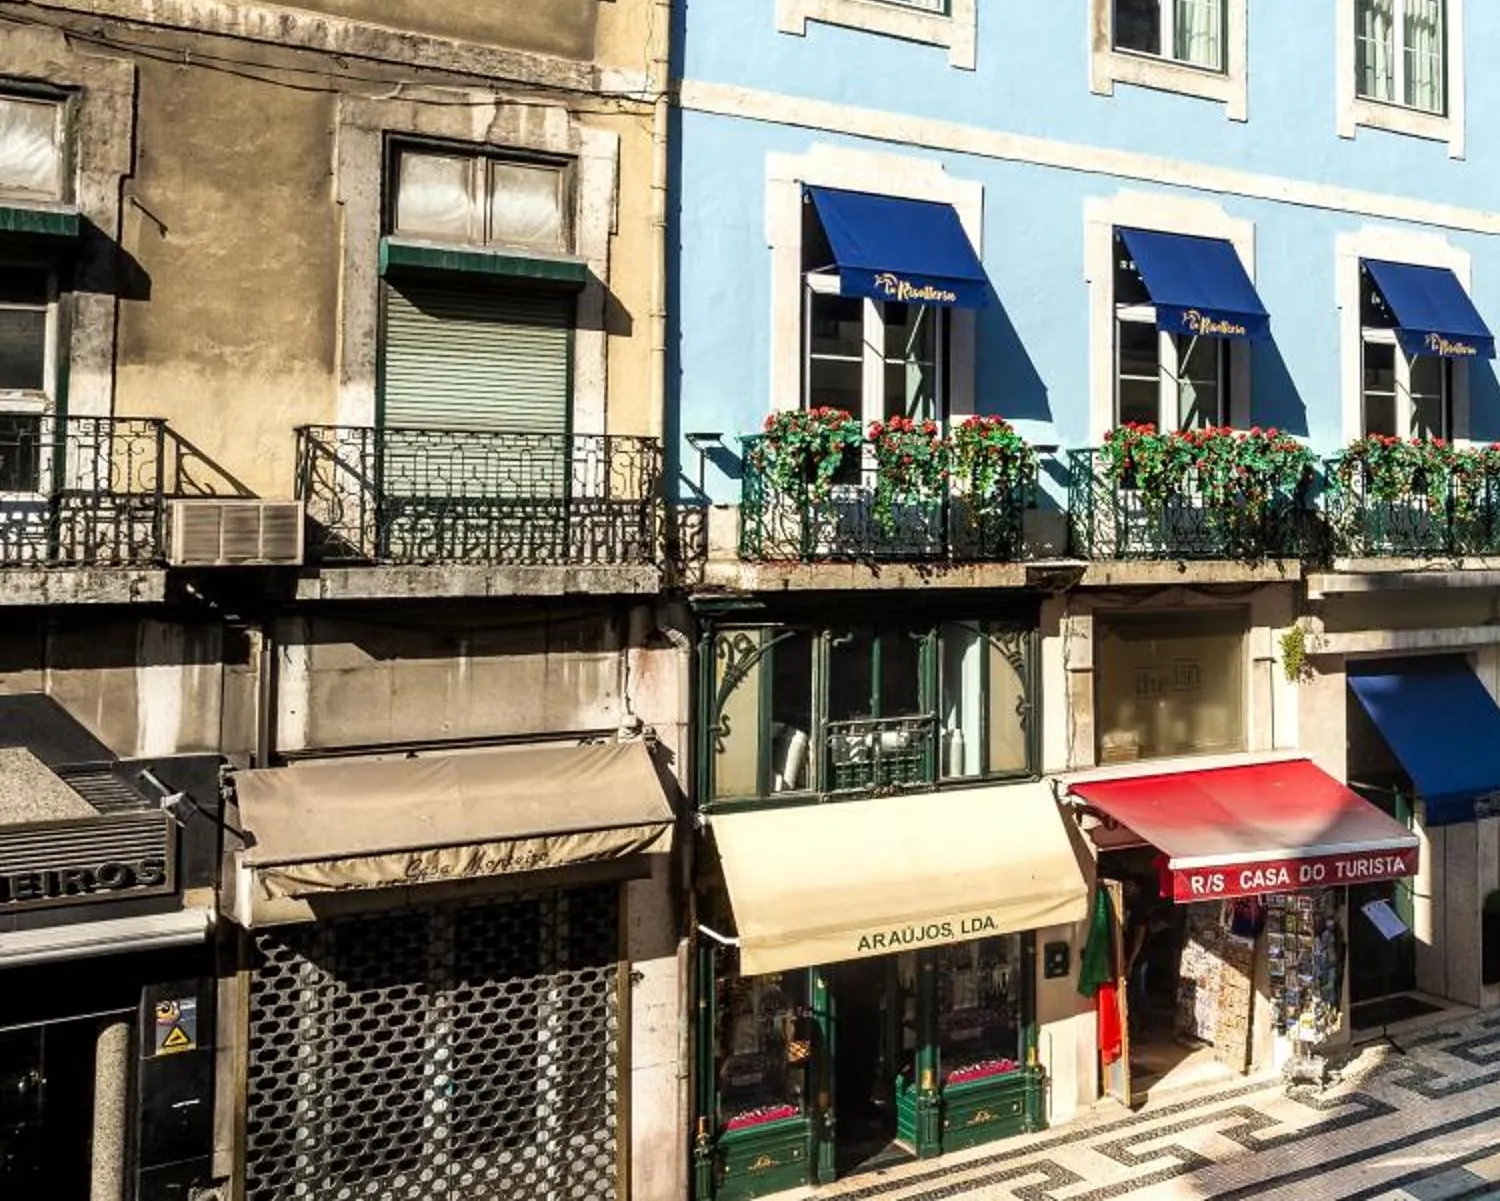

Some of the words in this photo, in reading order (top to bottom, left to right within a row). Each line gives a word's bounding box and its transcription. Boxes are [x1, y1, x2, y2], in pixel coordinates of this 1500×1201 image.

[1190, 874, 1225, 895] R/S
[1239, 867, 1291, 889] CASA
[1299, 863, 1325, 882] DO
[1335, 855, 1406, 879] TURISTA
[961, 915, 999, 935] LDA.
